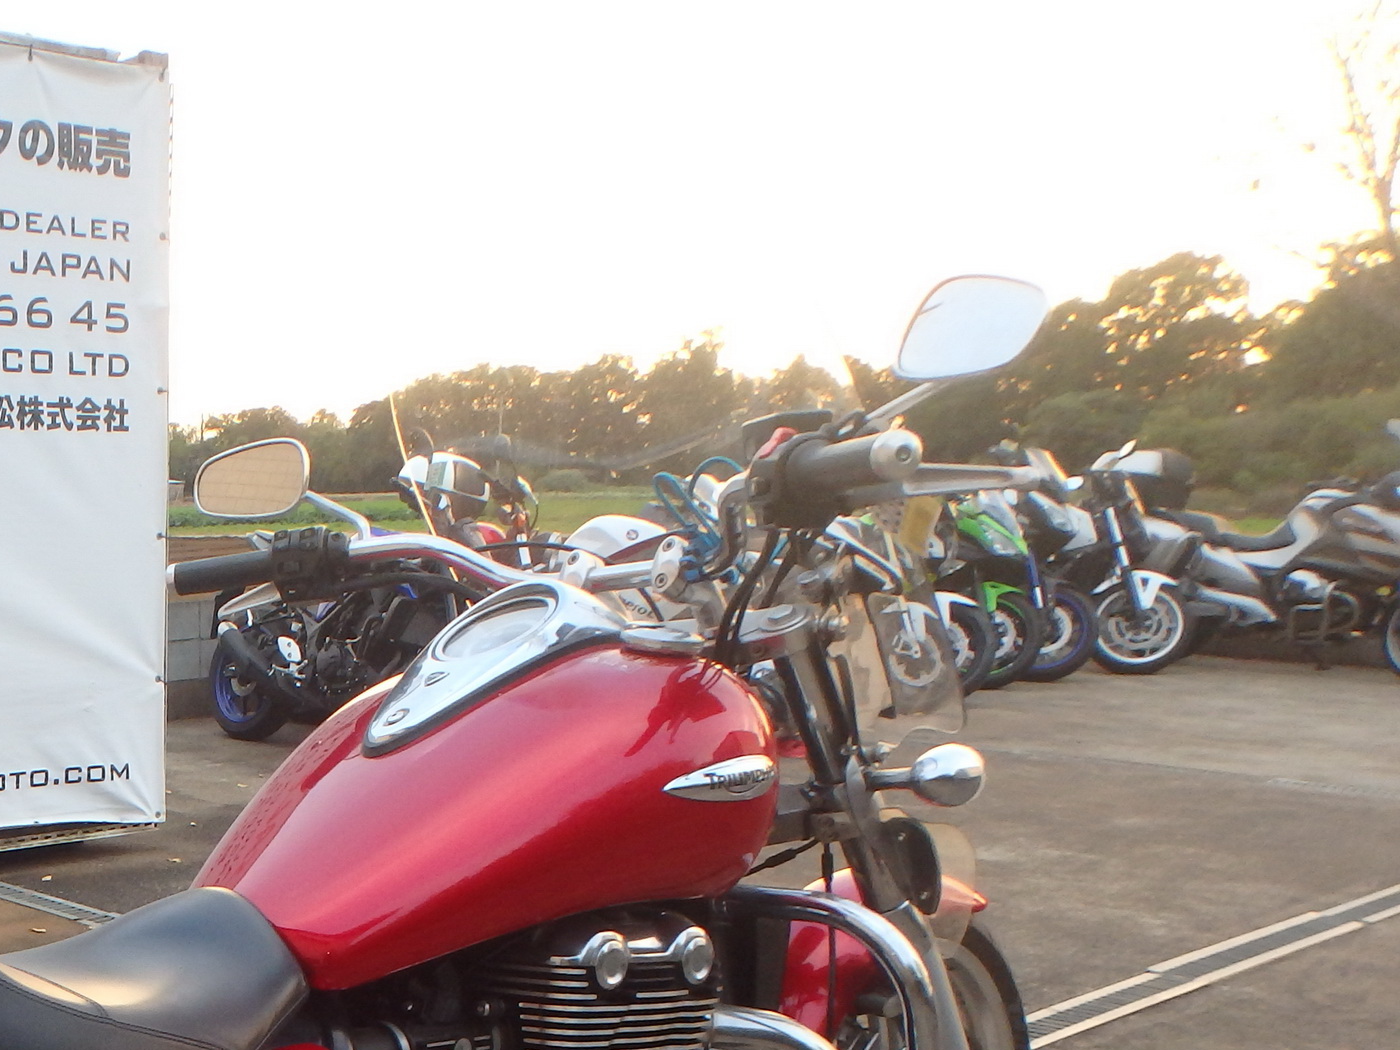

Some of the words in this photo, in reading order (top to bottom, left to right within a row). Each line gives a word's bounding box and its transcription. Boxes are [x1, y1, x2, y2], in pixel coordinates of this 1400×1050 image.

[0, 208, 130, 243] DEALER
[9, 249, 131, 283] JAPAN
[69, 300, 130, 334] 45
[1, 348, 54, 375] CO
[68, 351, 130, 378] LTD
